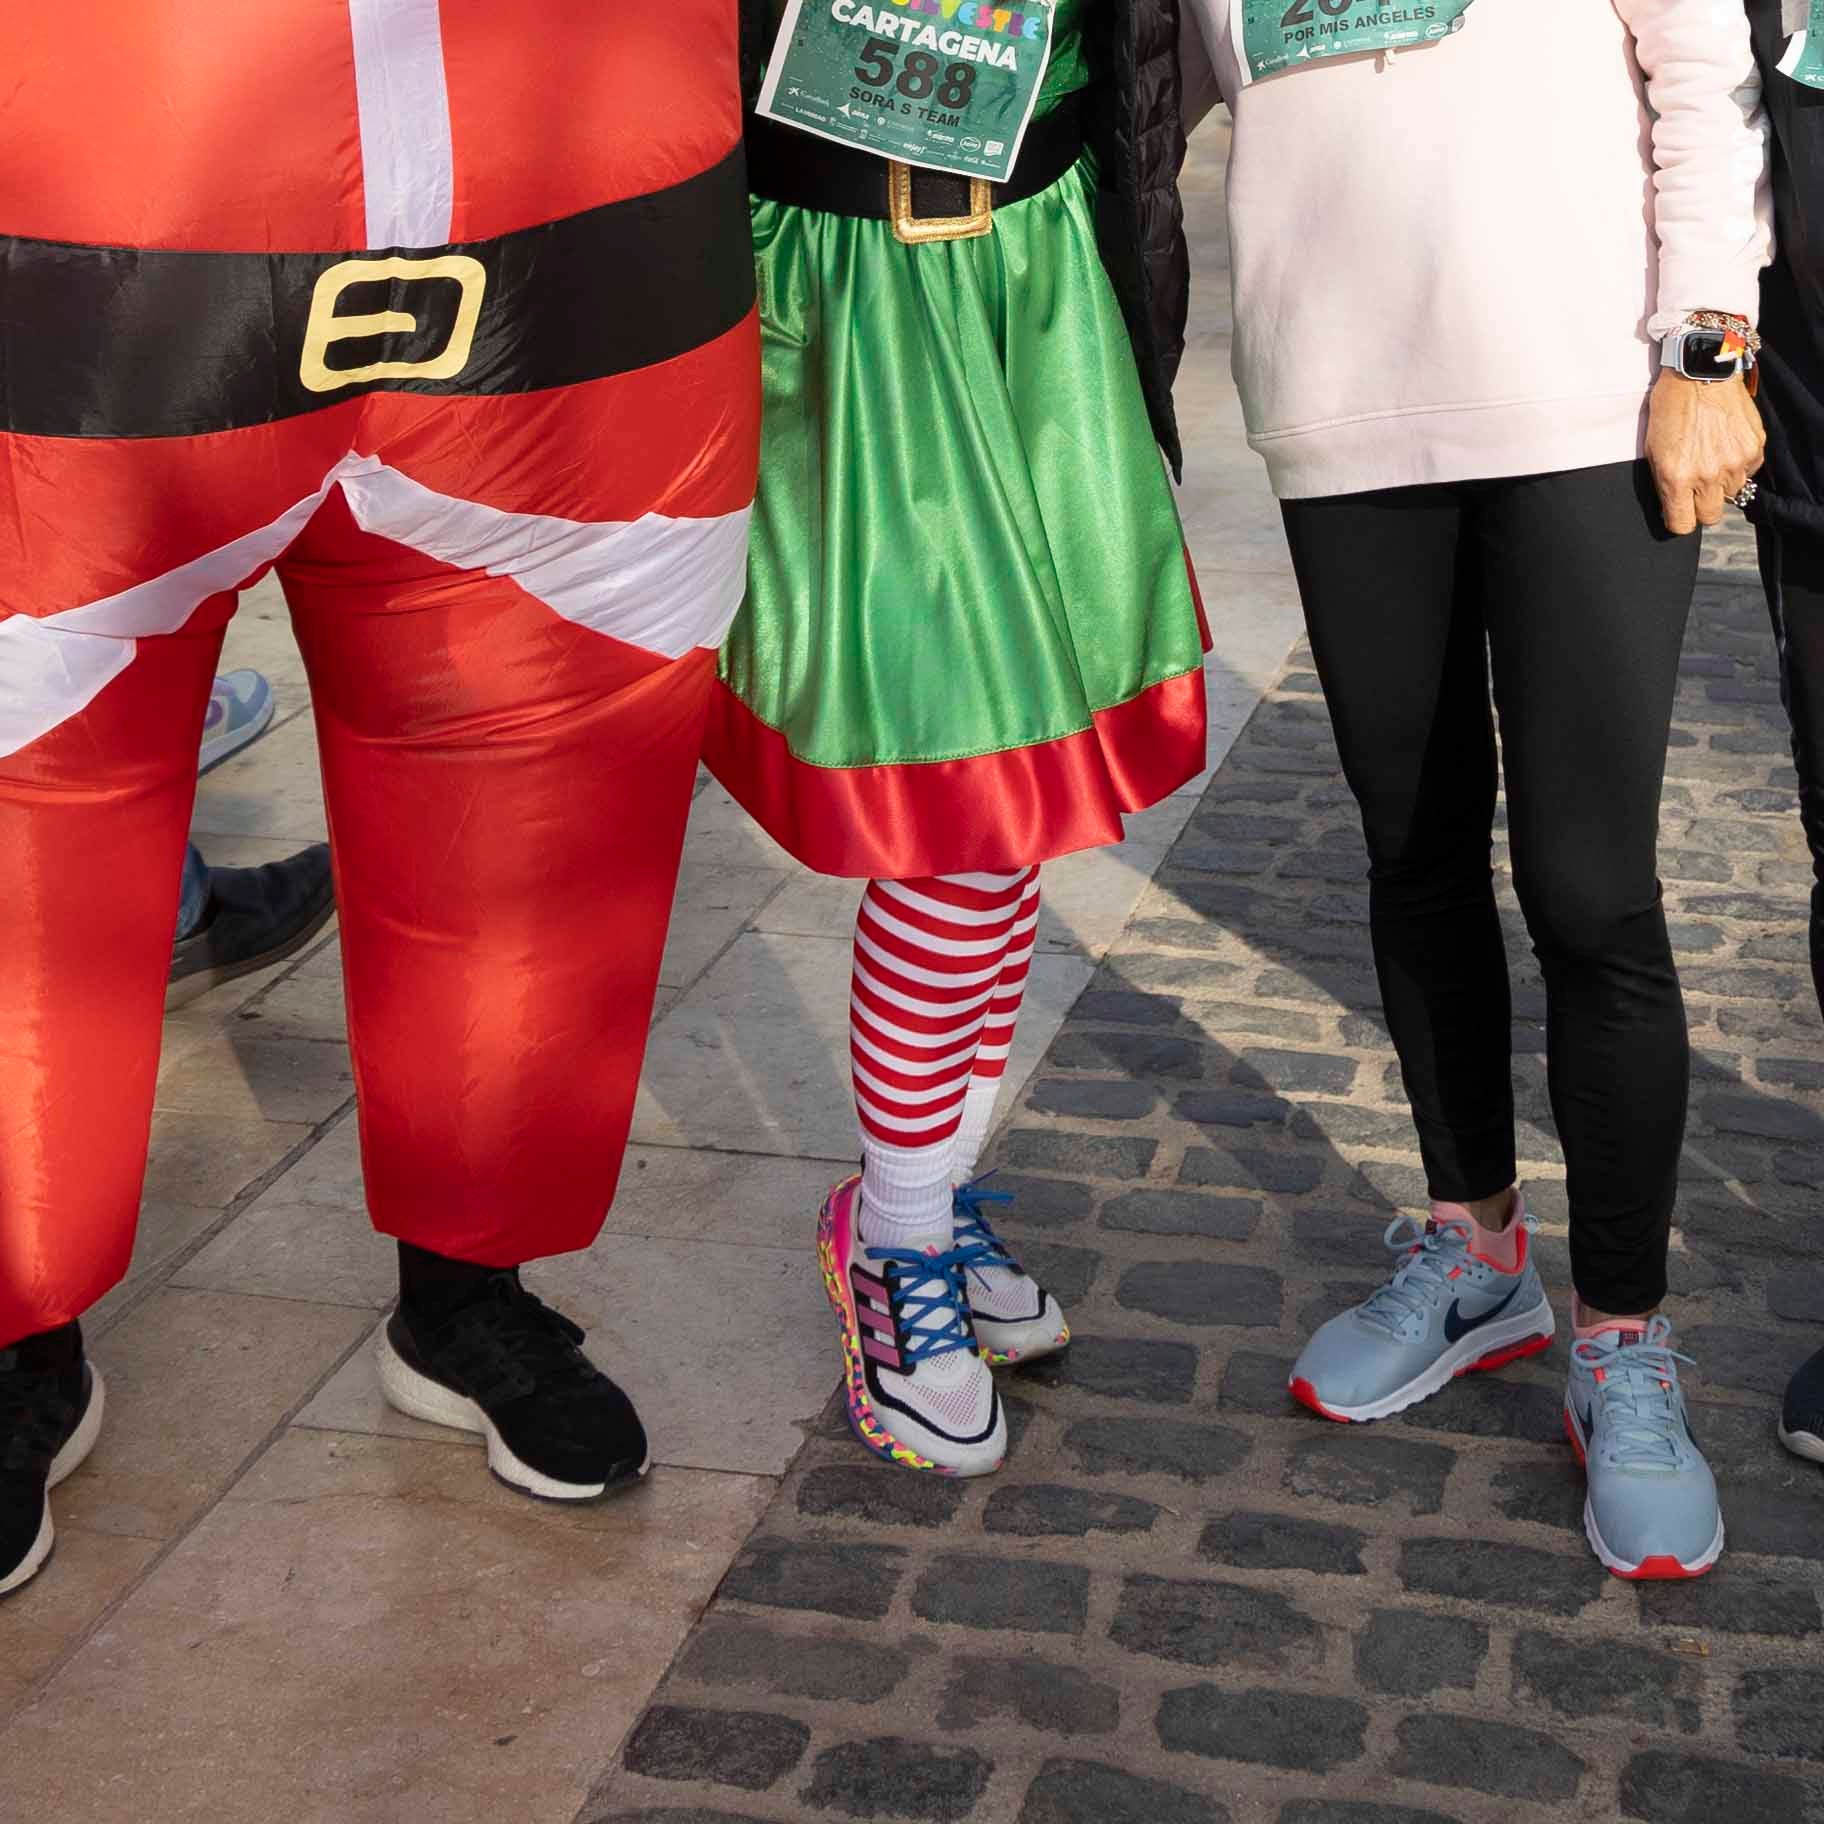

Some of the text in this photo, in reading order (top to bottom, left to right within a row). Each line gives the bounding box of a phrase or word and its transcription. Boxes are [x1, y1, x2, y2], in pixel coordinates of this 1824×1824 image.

[1284, 6, 1436, 44] POR MIS ANGELES
[853, 37, 977, 110] 588
[849, 86, 896, 113] SORA
[901, 102, 912, 116] S
[917, 106, 960, 128] TEAM
